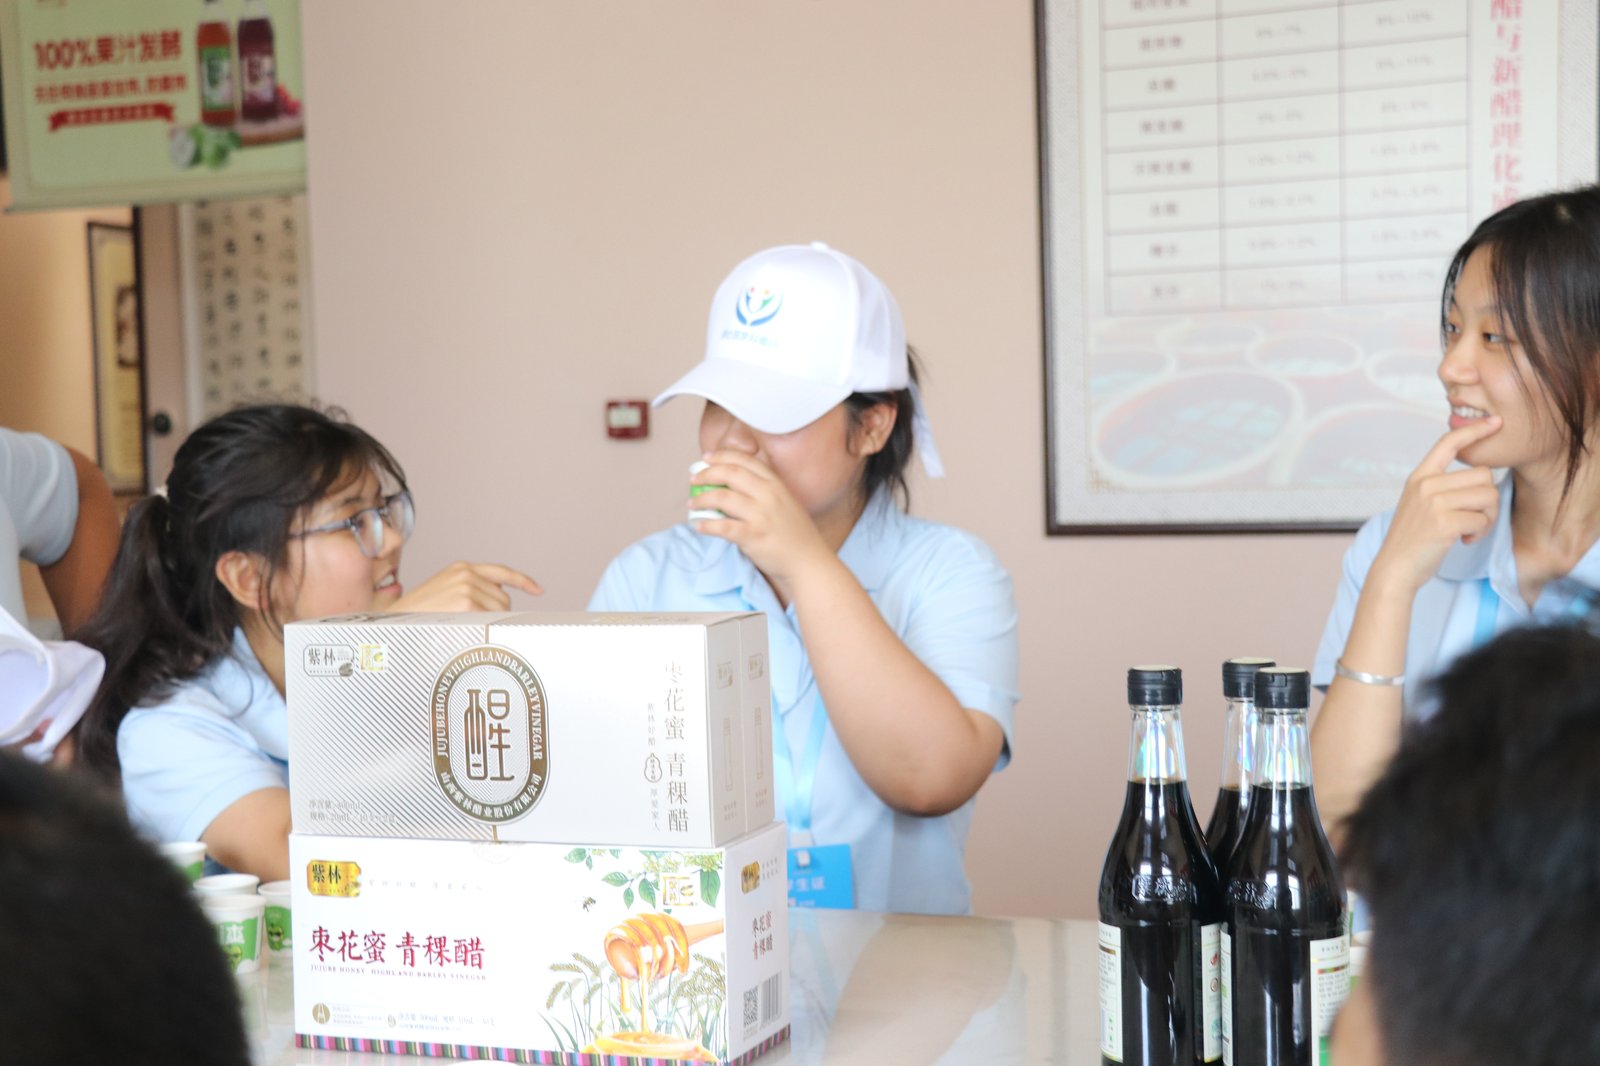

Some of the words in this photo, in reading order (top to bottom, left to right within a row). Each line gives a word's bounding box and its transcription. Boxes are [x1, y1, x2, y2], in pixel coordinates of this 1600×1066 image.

[34, 30, 182, 70] 100%果汁发酵
[308, 647, 336, 666] 紫林
[312, 864, 341, 885] 紫林
[310, 925, 387, 964] 枣花蜜
[396, 931, 485, 970] 青稞醋
[340, 966, 365, 974] HONEY
[371, 968, 414, 977] HIGHLAND
